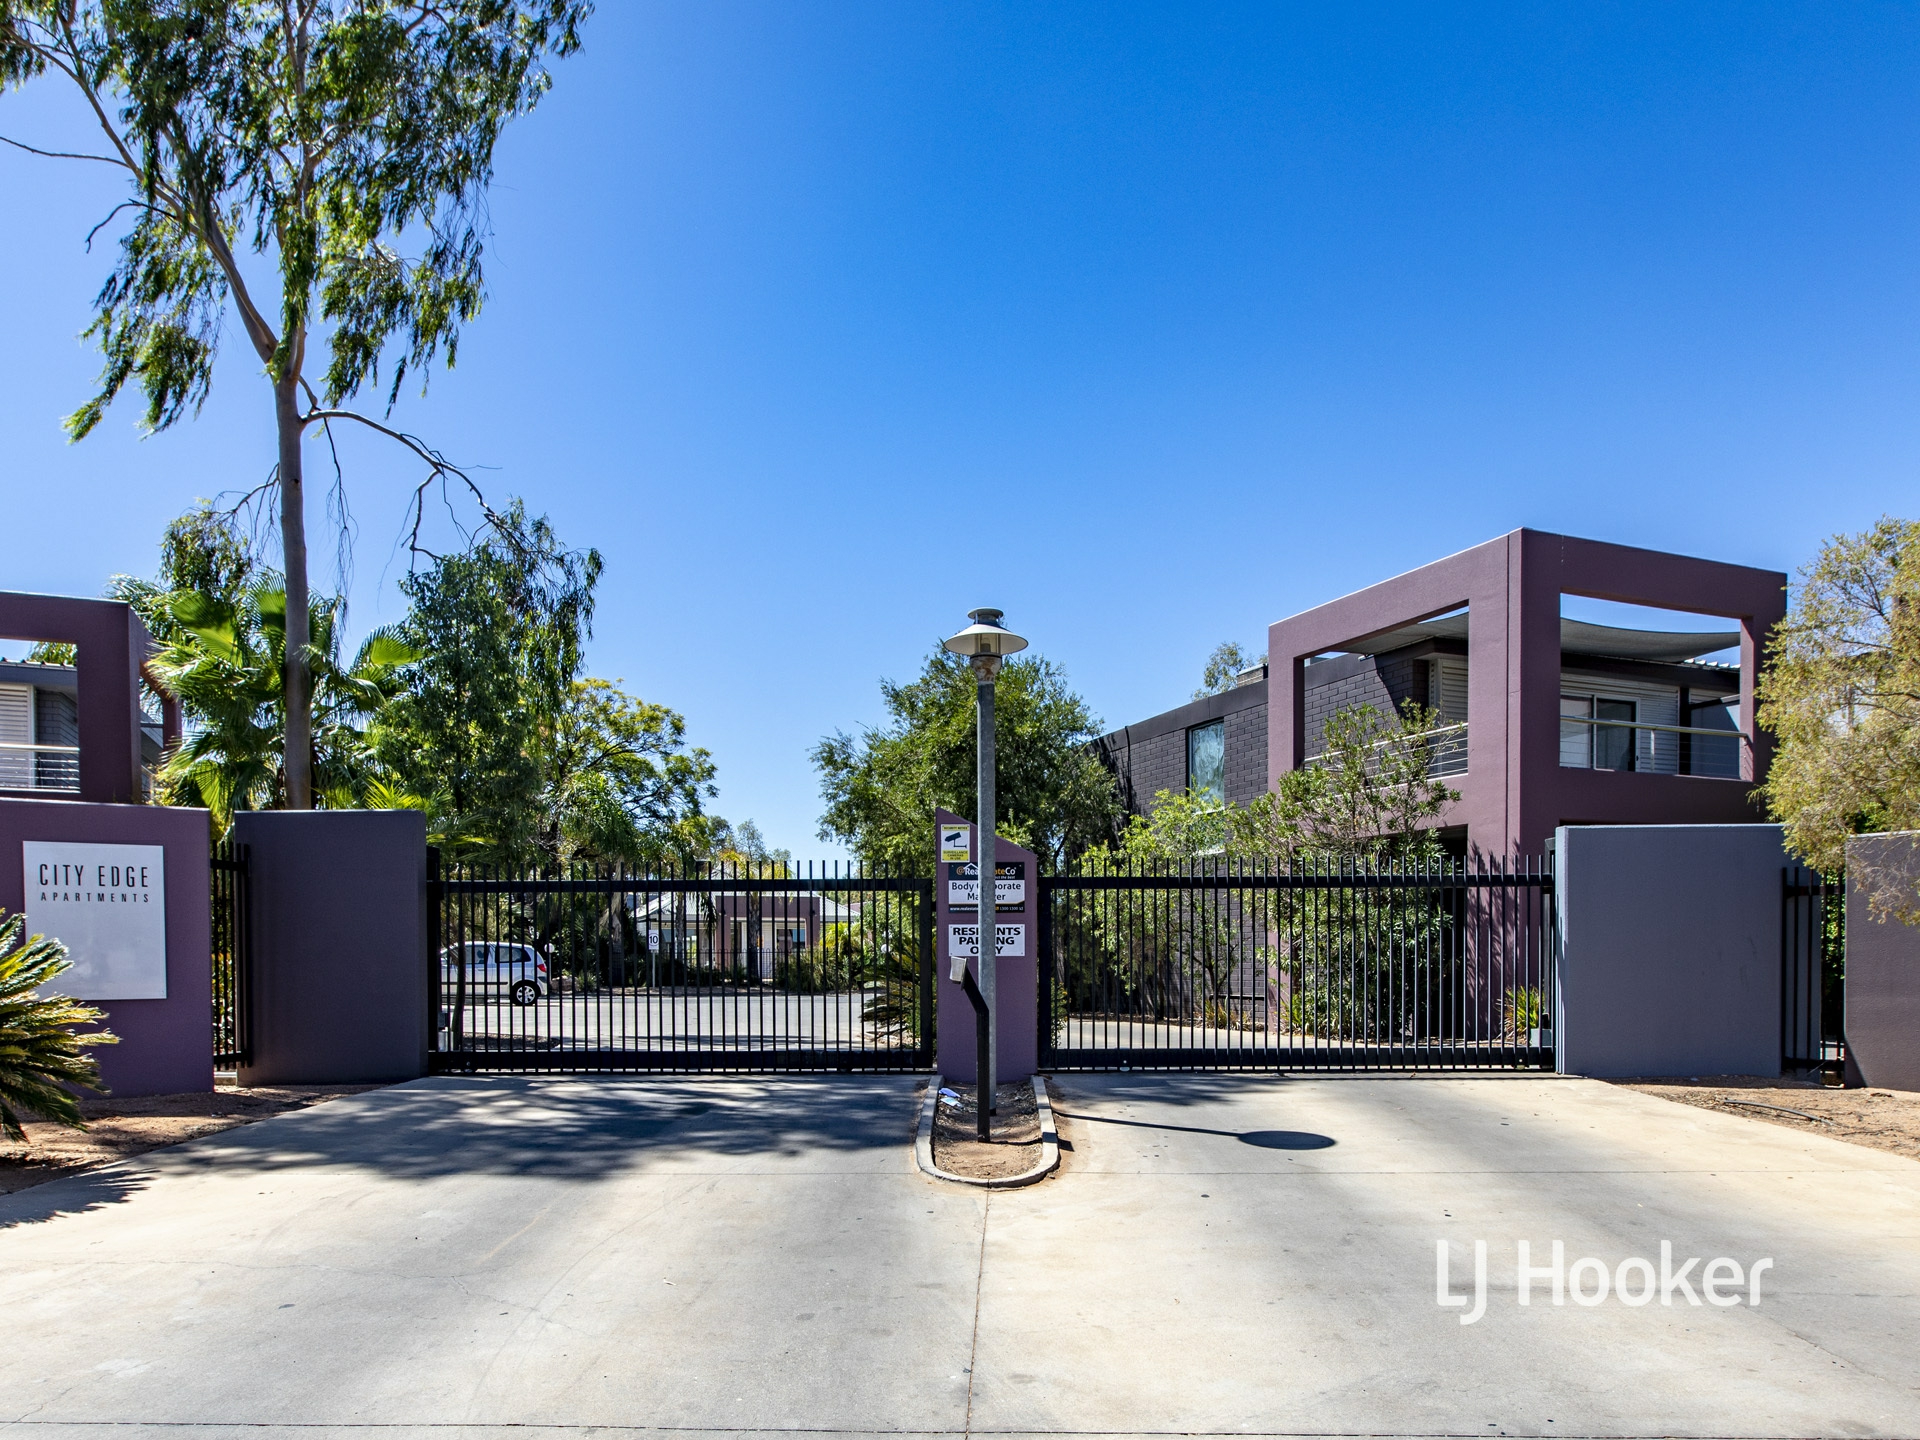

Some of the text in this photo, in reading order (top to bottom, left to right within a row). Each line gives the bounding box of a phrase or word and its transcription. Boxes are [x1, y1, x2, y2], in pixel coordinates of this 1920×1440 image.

[39, 864, 148, 888] CITY EDGE
[952, 882, 974, 892] Body
[40, 892, 149, 903] APARTMENTS
[650, 936, 658, 944] 10
[970, 946, 1003, 954] OY
